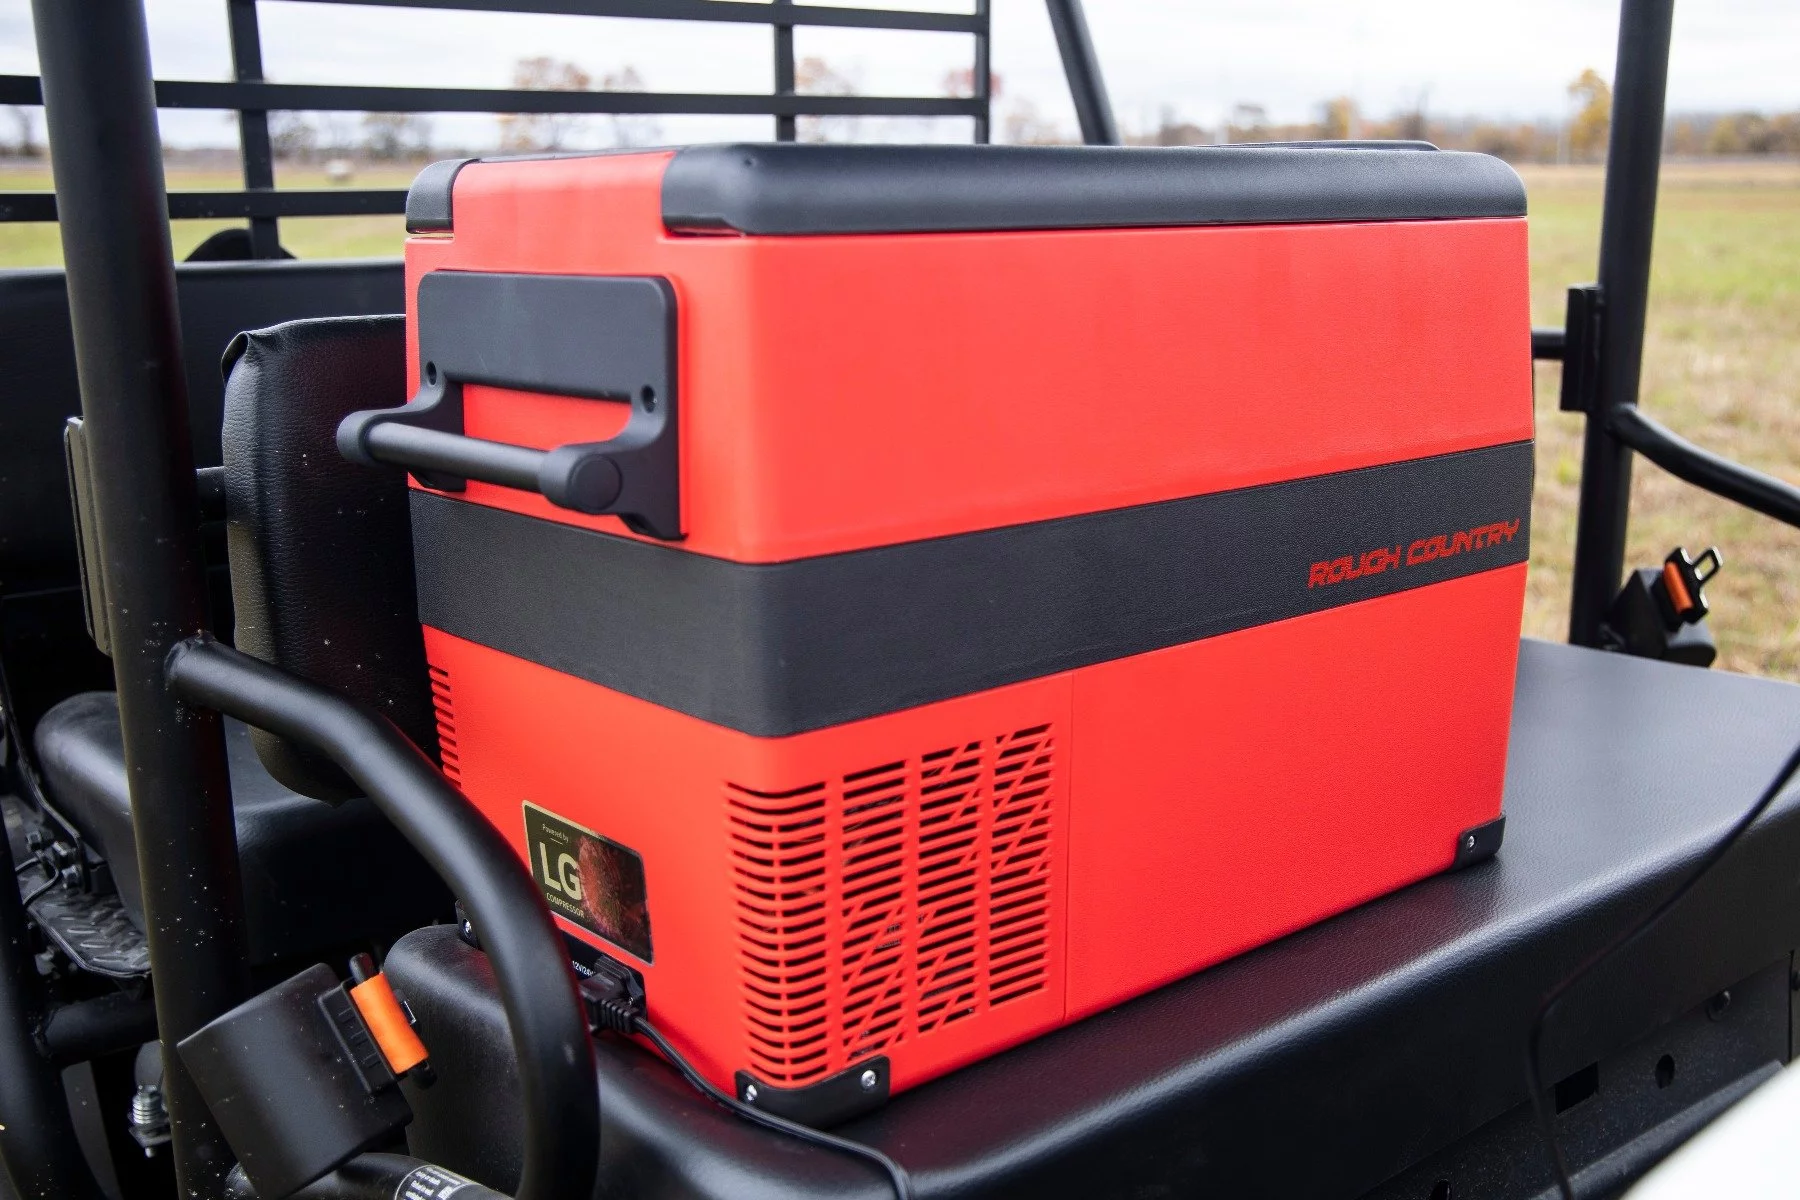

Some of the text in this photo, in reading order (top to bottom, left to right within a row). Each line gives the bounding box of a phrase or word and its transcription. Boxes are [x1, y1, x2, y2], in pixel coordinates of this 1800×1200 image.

[1308, 518, 1520, 589] ROUGH COUNTRY
[542, 823, 562, 840] Powered
[540, 842, 582, 901] LG
[546, 892, 585, 918] COMPRESSOR
